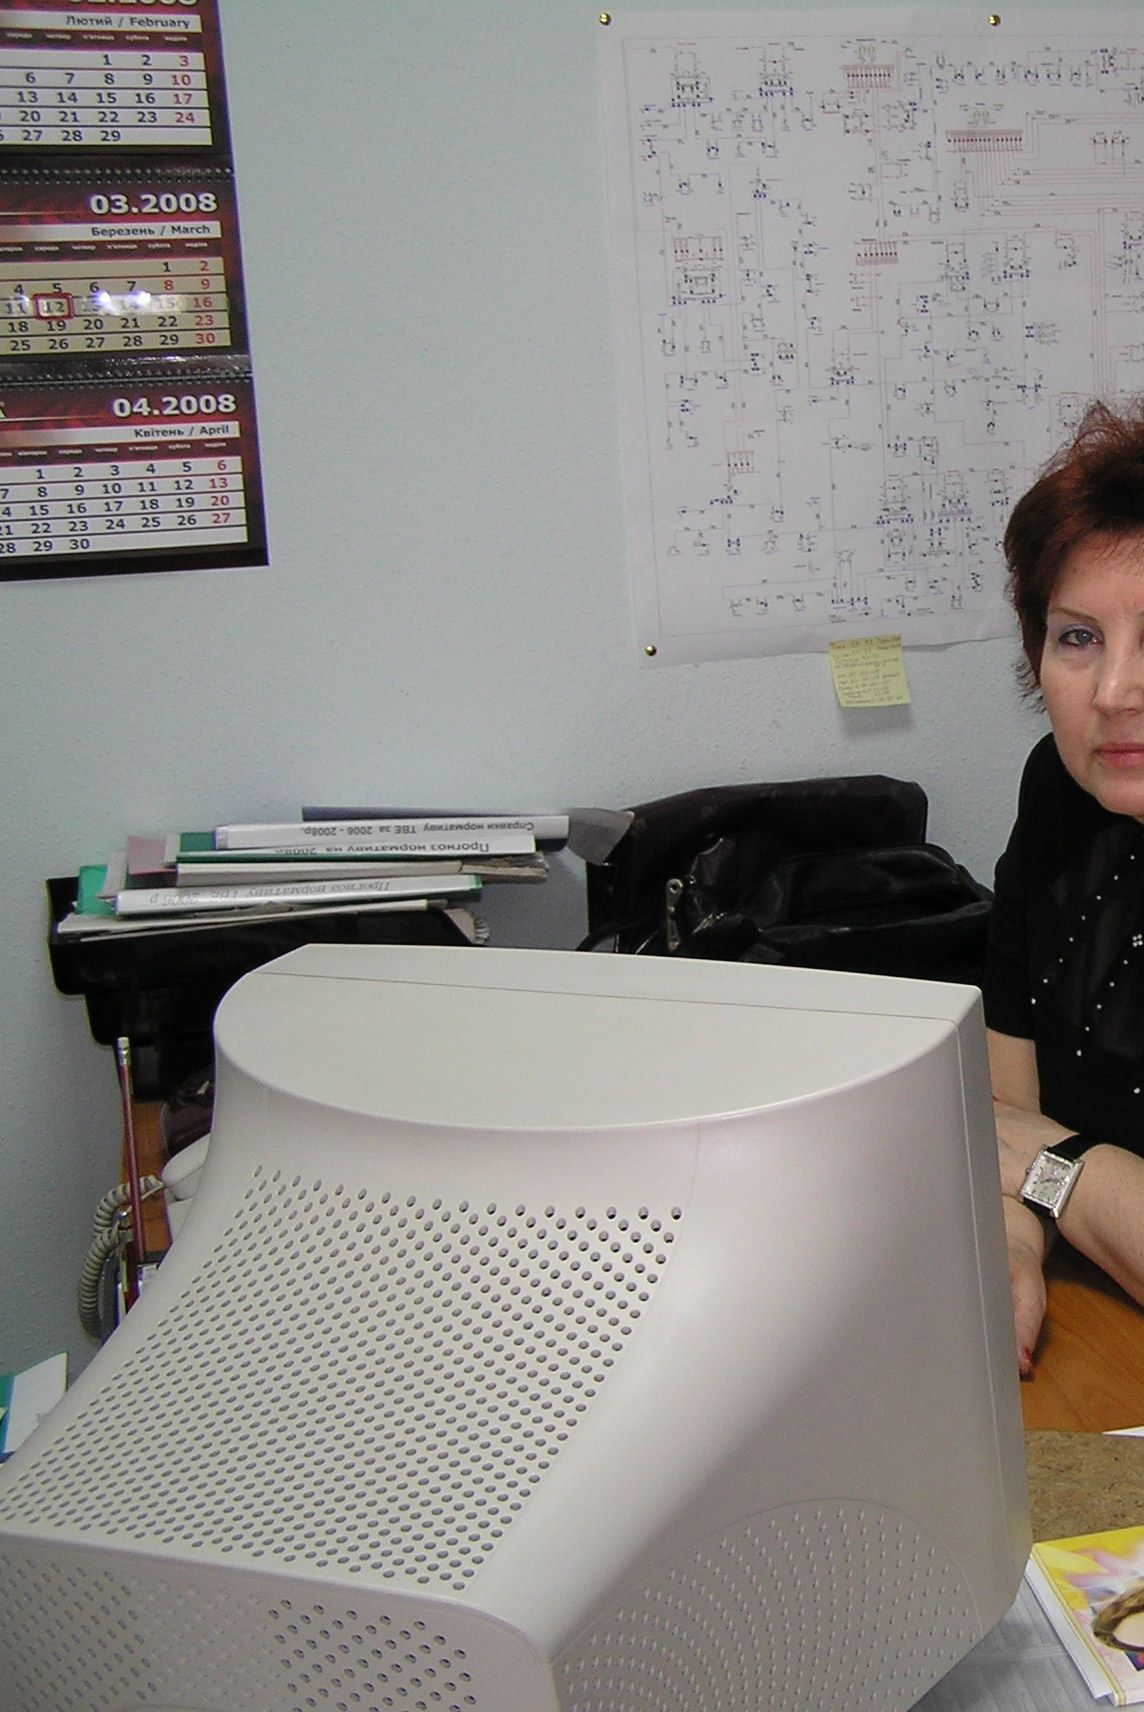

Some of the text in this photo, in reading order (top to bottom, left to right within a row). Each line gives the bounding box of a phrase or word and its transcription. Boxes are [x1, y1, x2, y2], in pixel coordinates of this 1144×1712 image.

[66, 15, 113, 26] Лютий
[130, 17, 190, 30] February
[103, 55, 189, 67] 1 2 3
[26, 73, 191, 86] 6 7 8 9 10
[17, 91, 193, 104] 13 14 15 16 17
[20, 110, 195, 123] 20 21 22 23 24
[22, 130, 121, 142] 27 28 29
[90, 193, 218, 215] 03.2008
[91, 226, 156, 238] Березень
[171, 224, 211, 235] March
[163, 261, 210, 272] 1 2
[14, 279, 211, 295] 4 5 6 7 8 9
[46, 302, 65, 313] 12
[194, 298, 213, 308] 16
[8, 316, 214, 333] 18 19 20 21 22 23
[10, 333, 216, 351] 25 26 27 28 29 30
[113, 394, 237, 417] 04.2008
[134, 427, 184, 438] Квітень
[200, 425, 230, 436] April
[37, 460, 227, 480] 1 2 3 4 5 6
[0, 478, 228, 499] 7 8 9 10 11 12 13
[29, 504, 50, 516] 15
[67, 503, 87, 514] 16
[104, 501, 124, 512] 17
[140, 499, 160, 510] 18
[176, 497, 195, 508] 19
[211, 495, 230, 506] 20
[31, 522, 52, 534] 22
[69, 520, 89, 532] 23
[105, 518, 126, 530] 24
[141, 517, 161, 528] 25
[177, 515, 197, 526] 26
[213, 513, 231, 524] 27
[33, 541, 53, 552] 29
[70, 539, 91, 550] 30
[347, 826, 373, 835] 2006
[394, 825, 417, 835] ТВЕ
[423, 823, 484, 833] нормативу
[487, 821, 535, 831] Справки
[347, 843, 426, 854] нормативу
[431, 842, 490, 853] Прогноз
[248, 884, 327, 897] нормативу
[331, 880, 390, 891] Прогноз
